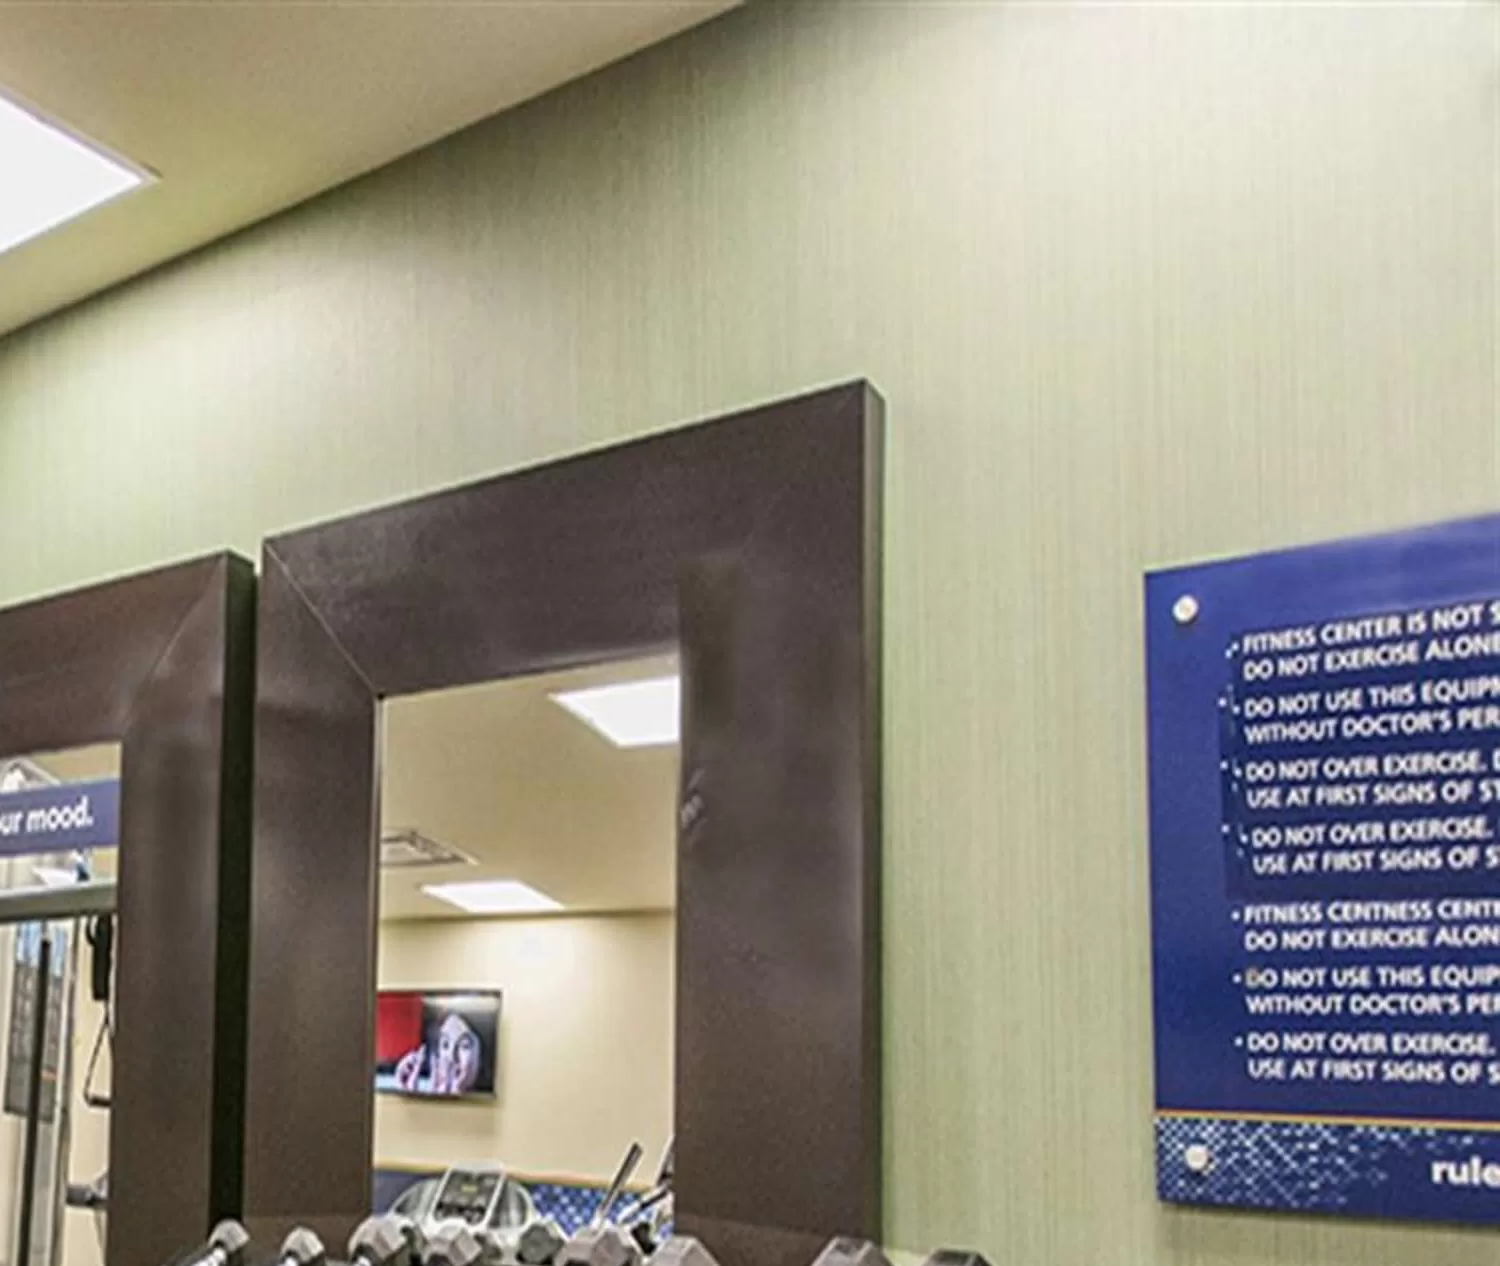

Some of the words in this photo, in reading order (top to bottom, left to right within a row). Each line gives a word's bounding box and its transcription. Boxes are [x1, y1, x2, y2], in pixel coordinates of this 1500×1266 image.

[1243, 626, 1316, 654] FITNESS
[1321, 615, 1401, 643] CENTER
[1407, 612, 1425, 633] IS
[1432, 604, 1484, 631] NOT
[1243, 658, 1274, 681] DO
[1277, 652, 1320, 677] NOT
[1324, 640, 1419, 672] EXERCISE
[1244, 696, 1274, 718] DO
[1278, 691, 1320, 715] NOT
[1325, 687, 1362, 711] USE
[1368, 681, 1414, 708] THIS
[1244, 717, 1337, 744] WITHOUT
[1342, 709, 1451, 738] DOCTOR'S
[1245, 759, 1275, 782] DO
[1278, 757, 1320, 780] NOT
[1323, 753, 1379, 779] OVER
[1246, 786, 1281, 809] USE
[1286, 784, 1311, 807] AT
[1315, 782, 1369, 806] FIRST
[1373, 779, 1437, 805] SIGNS
[1441, 779, 1474, 804] OF
[26, 795, 95, 834] mood.
[1252, 826, 1282, 849] DO
[1285, 823, 1326, 847] NOT
[1329, 819, 1385, 844] OVER
[1252, 853, 1287, 875] USE
[1292, 850, 1318, 873] AT
[1322, 848, 1375, 872] FIRST
[1380, 846, 1443, 871] SIGNS
[1448, 844, 1480, 870] OF
[1244, 903, 1323, 925] FITNESS
[1327, 899, 1433, 921] CENTNESS
[1244, 929, 1278, 951] DO
[1282, 928, 1326, 950] NOT
[1331, 926, 1428, 949] EXERCISE
[1245, 966, 1279, 989] DO
[1283, 966, 1327, 988] NOT
[1332, 966, 1372, 988] USE
[1376, 963, 1425, 987] THIS
[1245, 993, 1345, 1016] WITHOUT
[1349, 992, 1461, 1017] DOCTOR'S
[1247, 1031, 1280, 1053] DO
[1283, 1031, 1328, 1053] NOT
[1329, 1031, 1387, 1054] OVER
[1248, 1058, 1286, 1081] USE
[1290, 1058, 1318, 1080] AT
[1322, 1058, 1378, 1081] FIRST
[1381, 1059, 1446, 1084] SIGNS
[1450, 1060, 1482, 1085] OF
